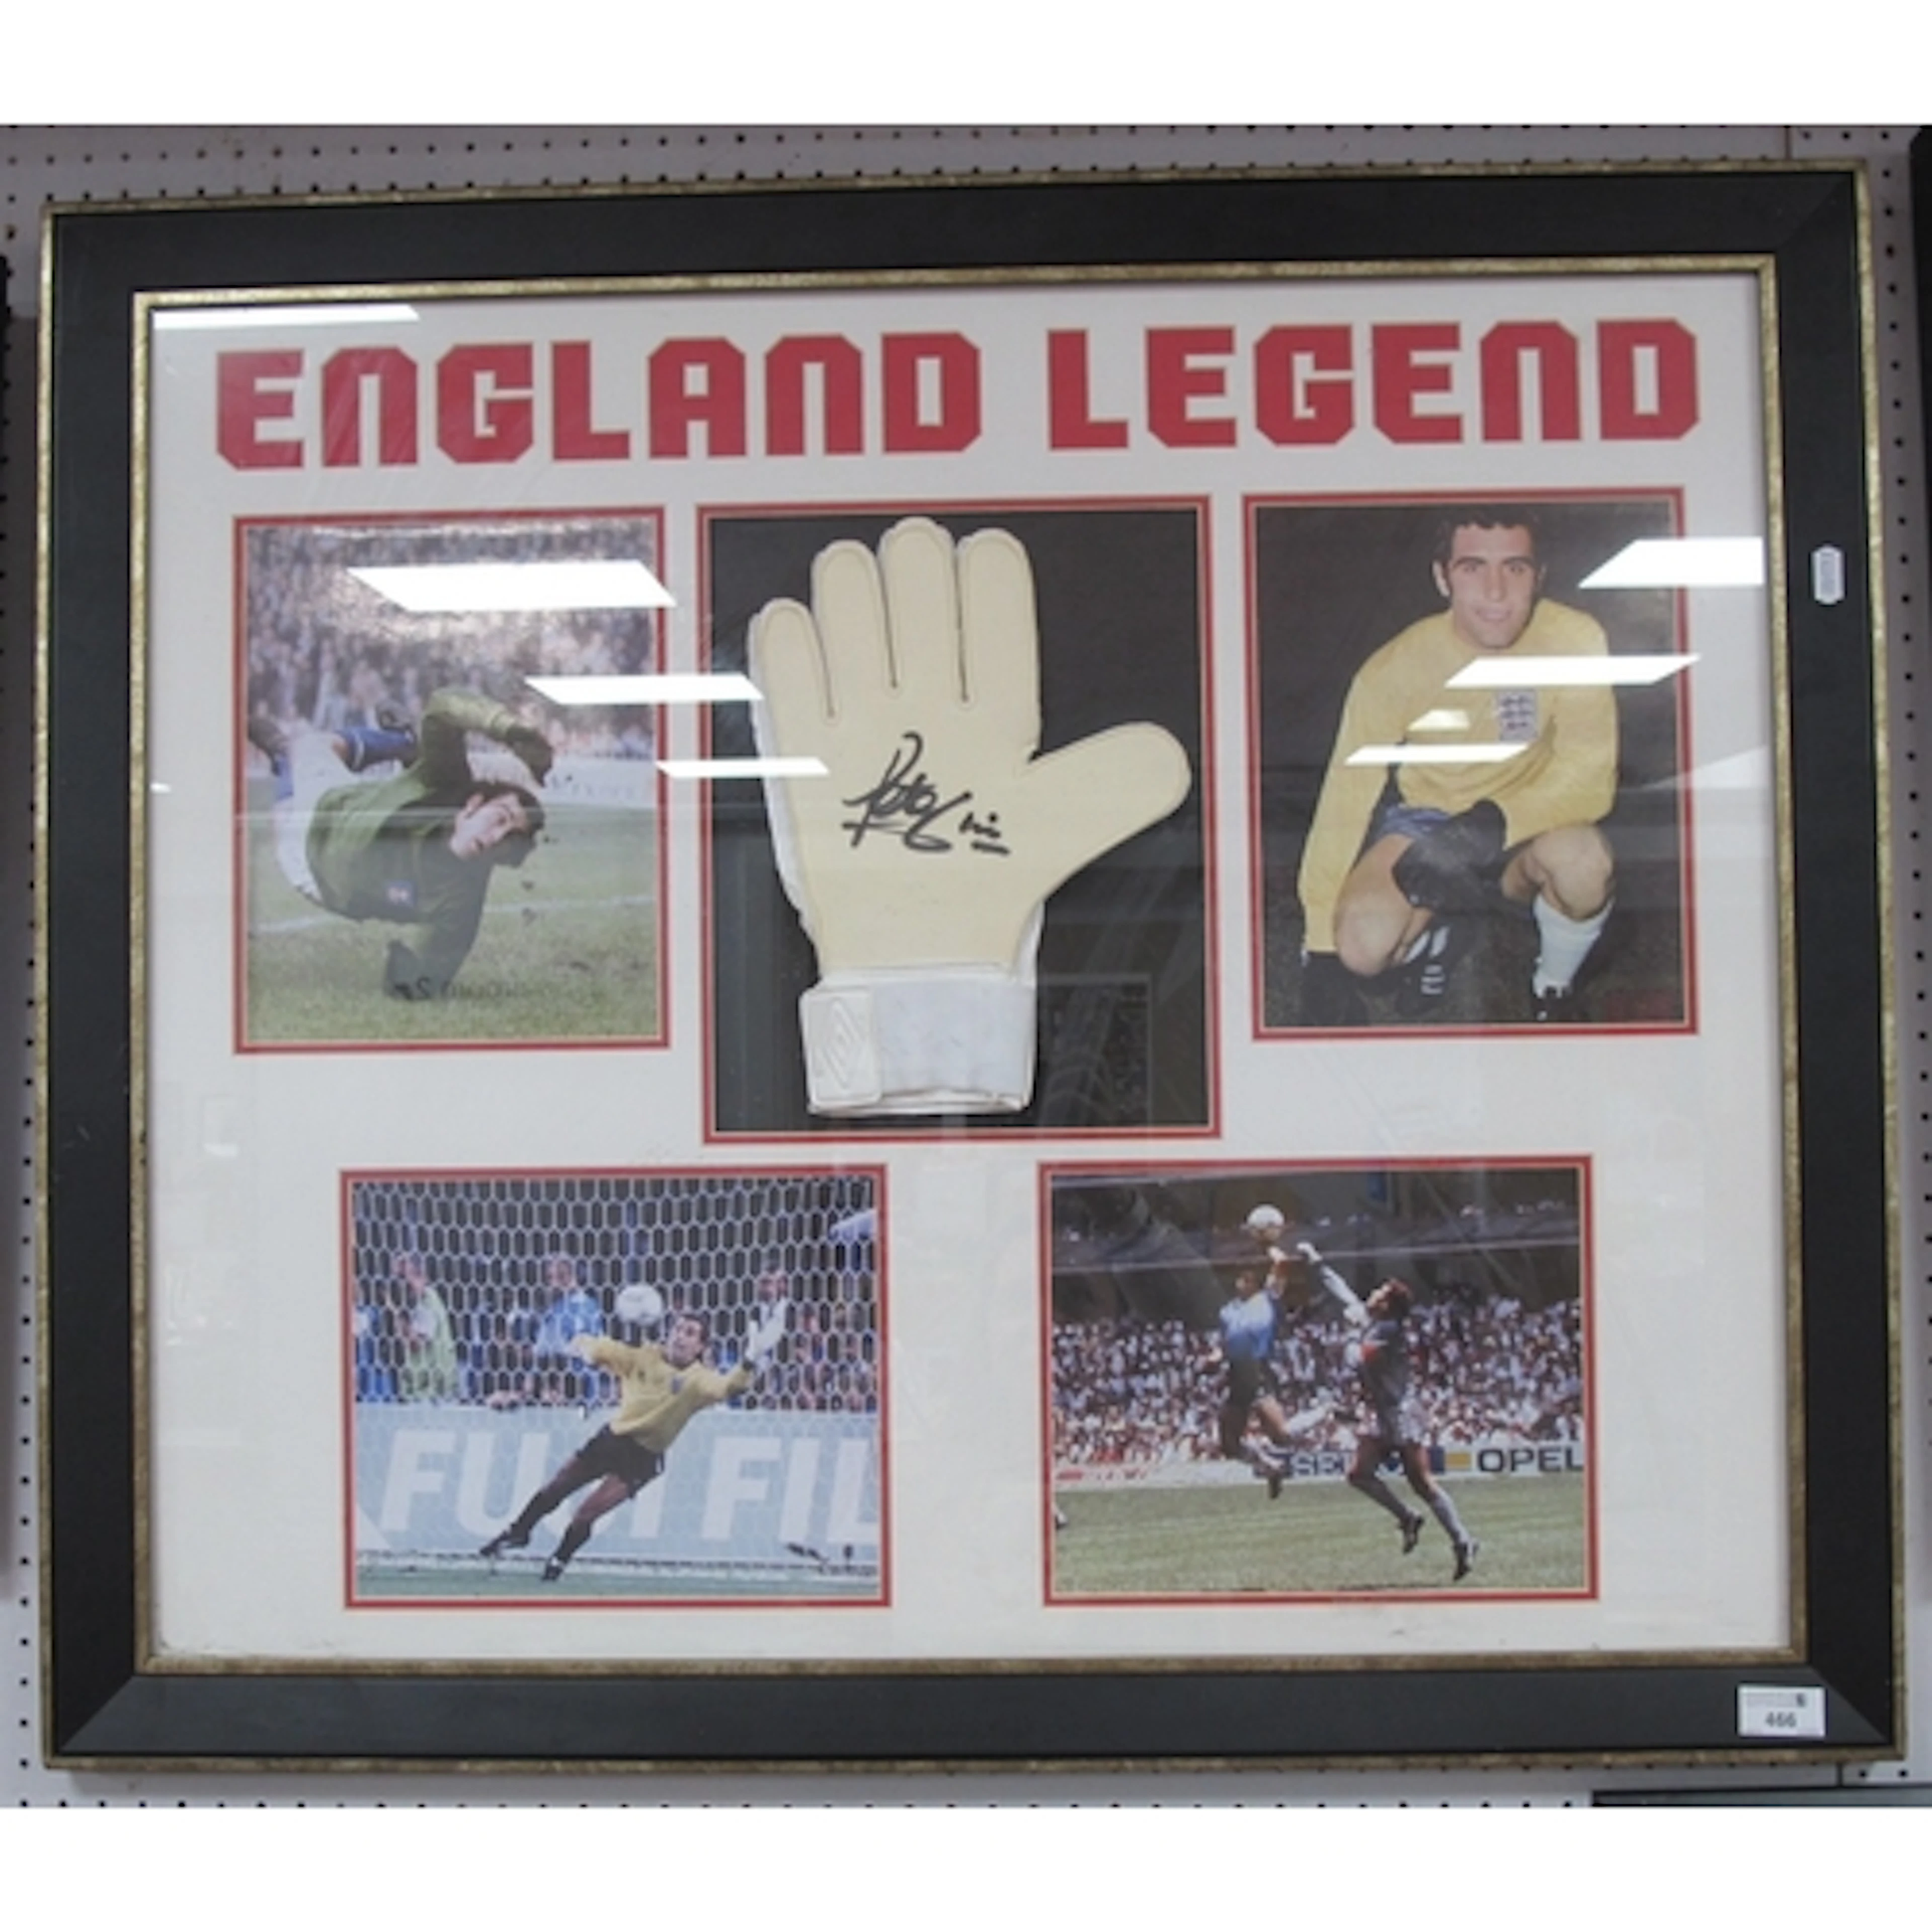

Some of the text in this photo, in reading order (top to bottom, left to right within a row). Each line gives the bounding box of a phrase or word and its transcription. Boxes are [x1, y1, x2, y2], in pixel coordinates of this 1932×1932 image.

[216, 318, 1701, 470] ENGLAND LEGEND
[379, 1428, 673, 1540] FUI
[1477, 1446, 1583, 1473] OPEL
